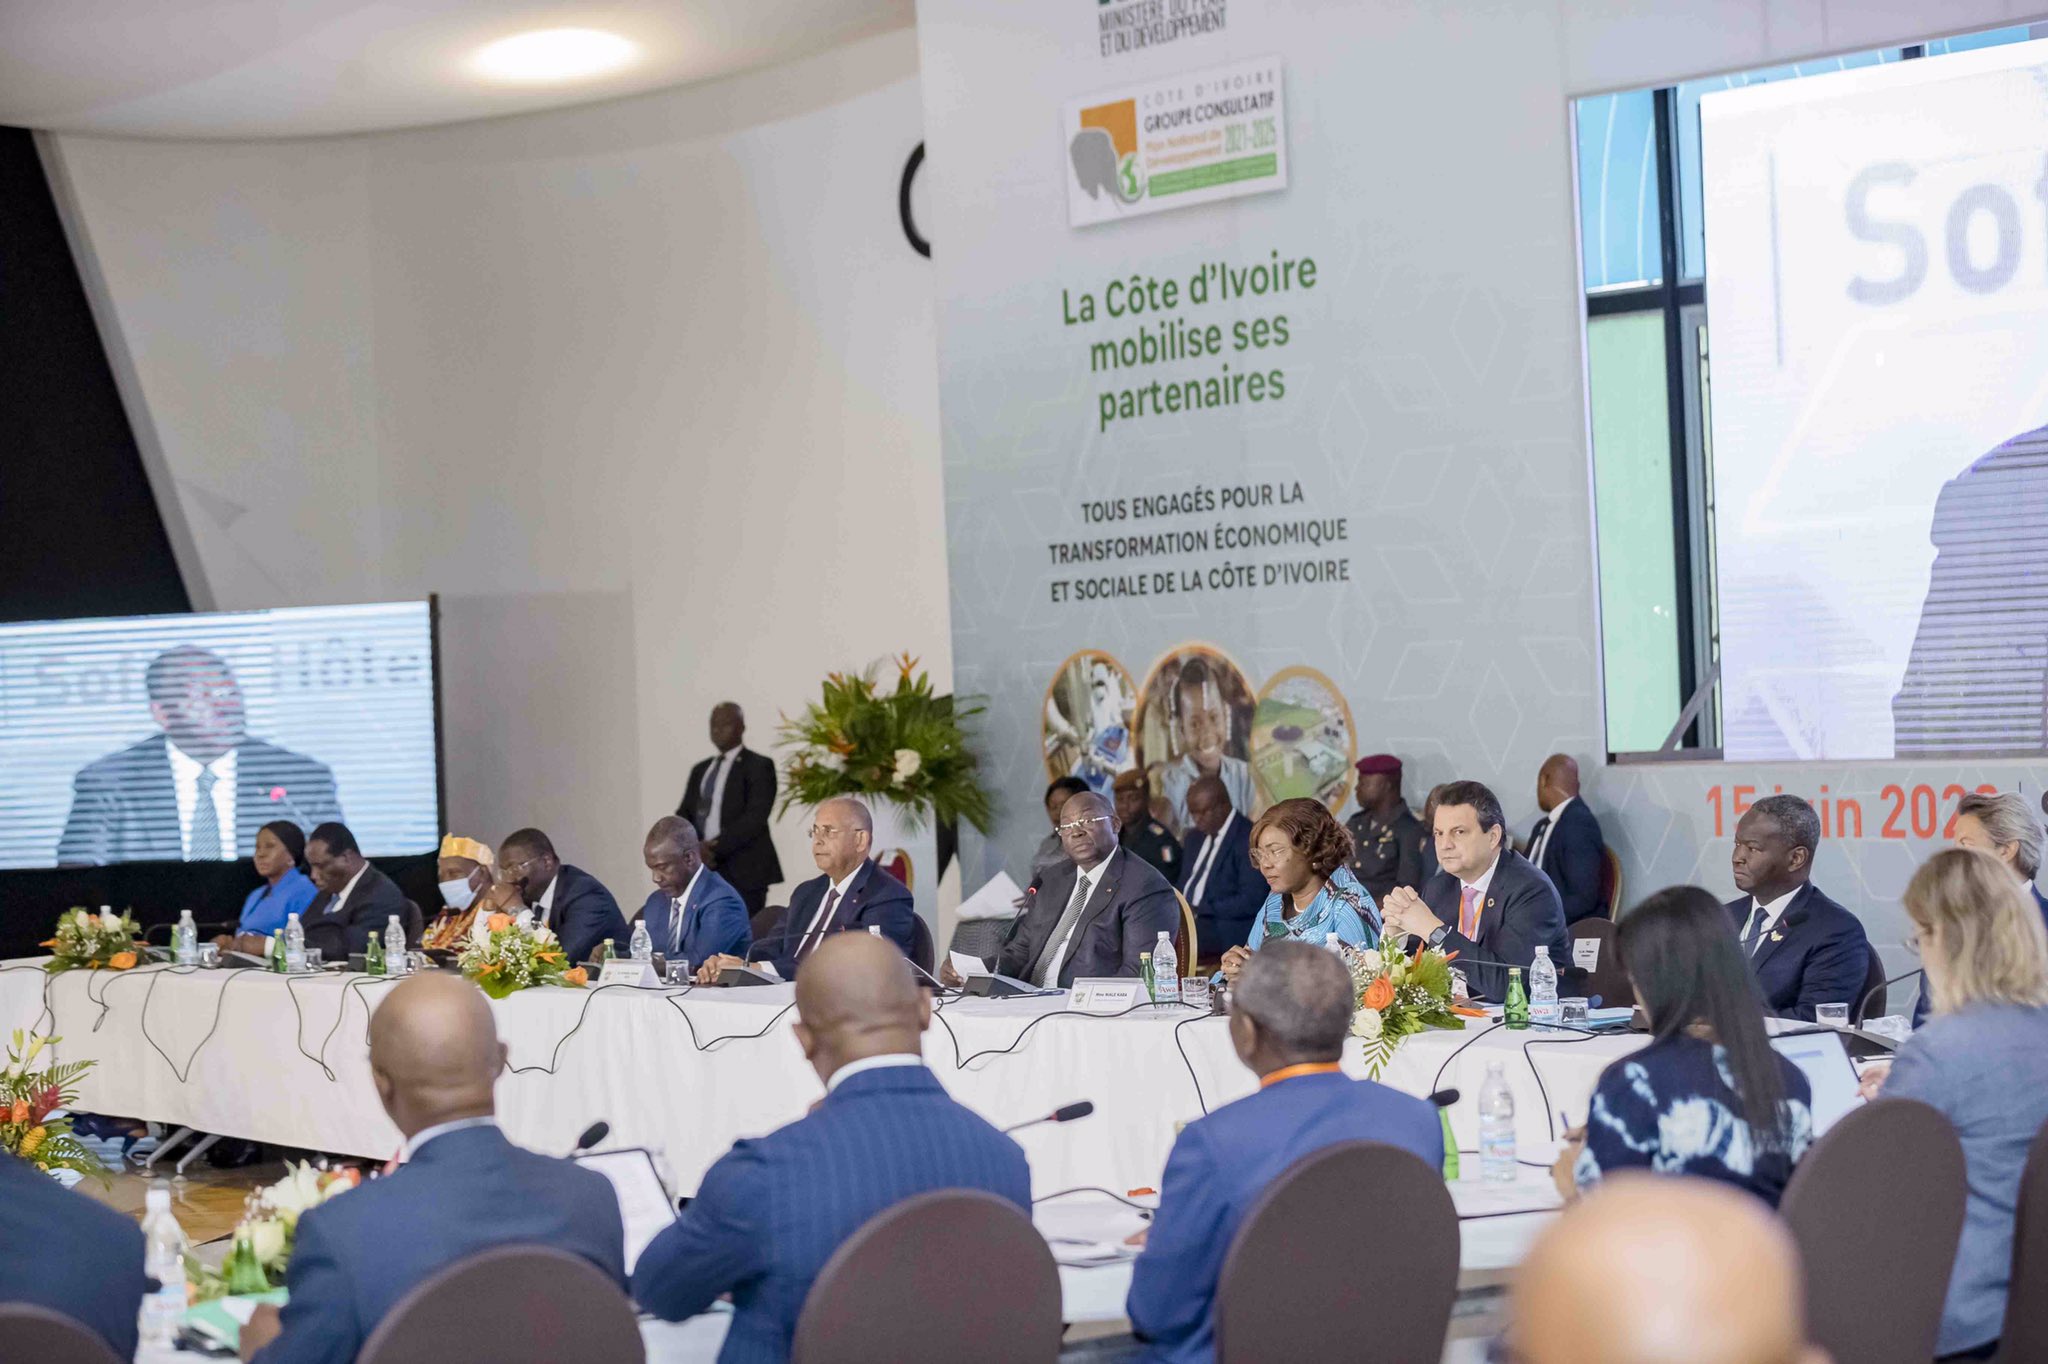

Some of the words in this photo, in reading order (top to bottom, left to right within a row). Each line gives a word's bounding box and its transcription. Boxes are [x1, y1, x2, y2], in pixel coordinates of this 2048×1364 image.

[1144, 107, 1192, 133] GROUPE
[1195, 90, 1274, 122] CONSULTATIF
[1062, 288, 1095, 325] La
[1106, 275, 1179, 319] Côte
[1091, 317, 1222, 373] mobilise
[1232, 315, 1290, 351] ses
[1100, 363, 1286, 433] partenaires
[1082, 499, 1127, 523] TOUS
[1133, 485, 1216, 519] ENGAGÉS
[1222, 484, 1274, 510] POUR
[1279, 481, 1304, 504] LA
[1048, 530, 1208, 565] TRANSFORMATION
[1214, 518, 1348, 550] ÉCONOMIQUE
[1051, 581, 1070, 603] ET
[1074, 574, 1148, 602] SOCIALE
[1154, 572, 1176, 594] DE
[1181, 569, 1203, 592] LA
[1208, 561, 1257, 590] CÔTE
[1879, 783, 1998, 840] 202
